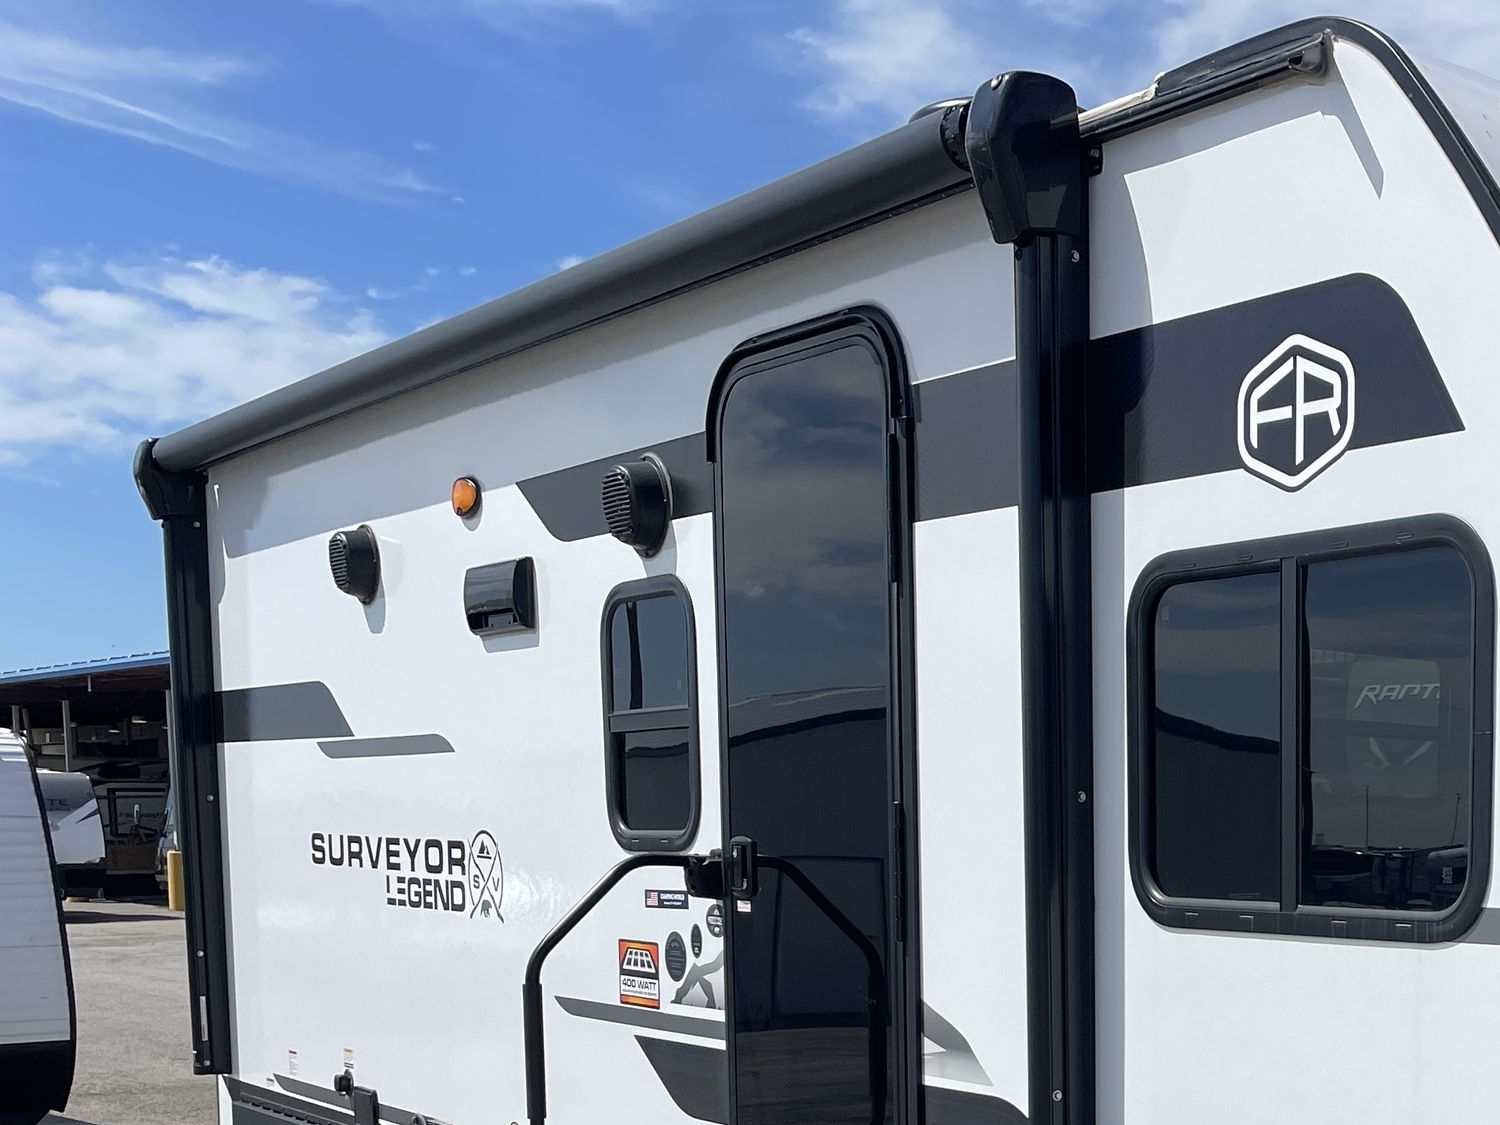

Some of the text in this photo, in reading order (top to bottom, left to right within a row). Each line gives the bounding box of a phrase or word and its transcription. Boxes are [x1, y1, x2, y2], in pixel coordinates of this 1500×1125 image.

[1352, 683, 1441, 711] RAPT
[311, 832, 467, 876] SURVEYOR
[386, 875, 466, 912] LEGEND
[622, 978, 657, 992] 400 WATT
